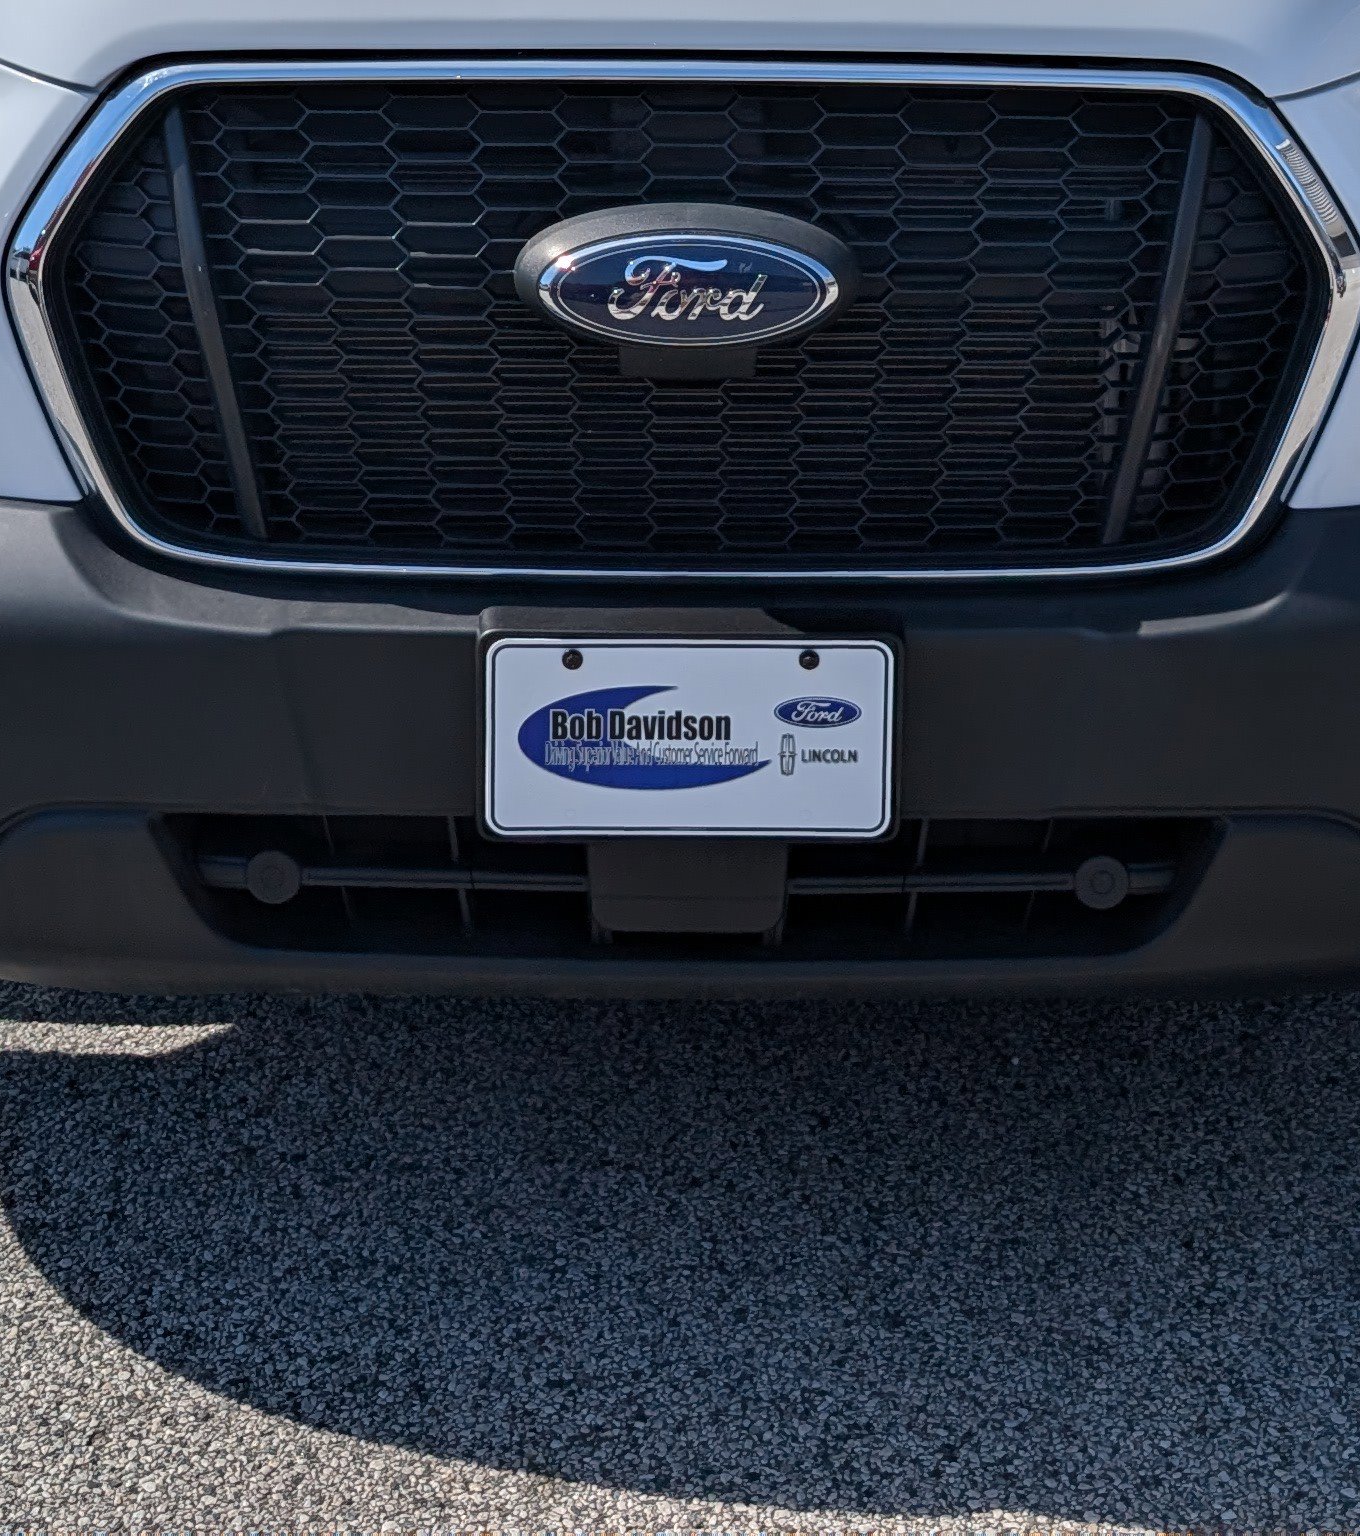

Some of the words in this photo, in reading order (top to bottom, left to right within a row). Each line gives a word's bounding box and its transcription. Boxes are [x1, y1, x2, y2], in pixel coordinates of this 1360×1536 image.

[607, 255, 769, 321] Ford
[551, 709, 603, 741] Bob
[608, 709, 731, 741] Davidson
[790, 700, 845, 722] Ford
[544, 741, 576, 772] Driving
[575, 741, 611, 772] Superior
[652, 740, 694, 766] Customer
[693, 740, 724, 766] Service
[724, 740, 759, 766] Forward
[800, 748, 859, 764] LINCOLN
